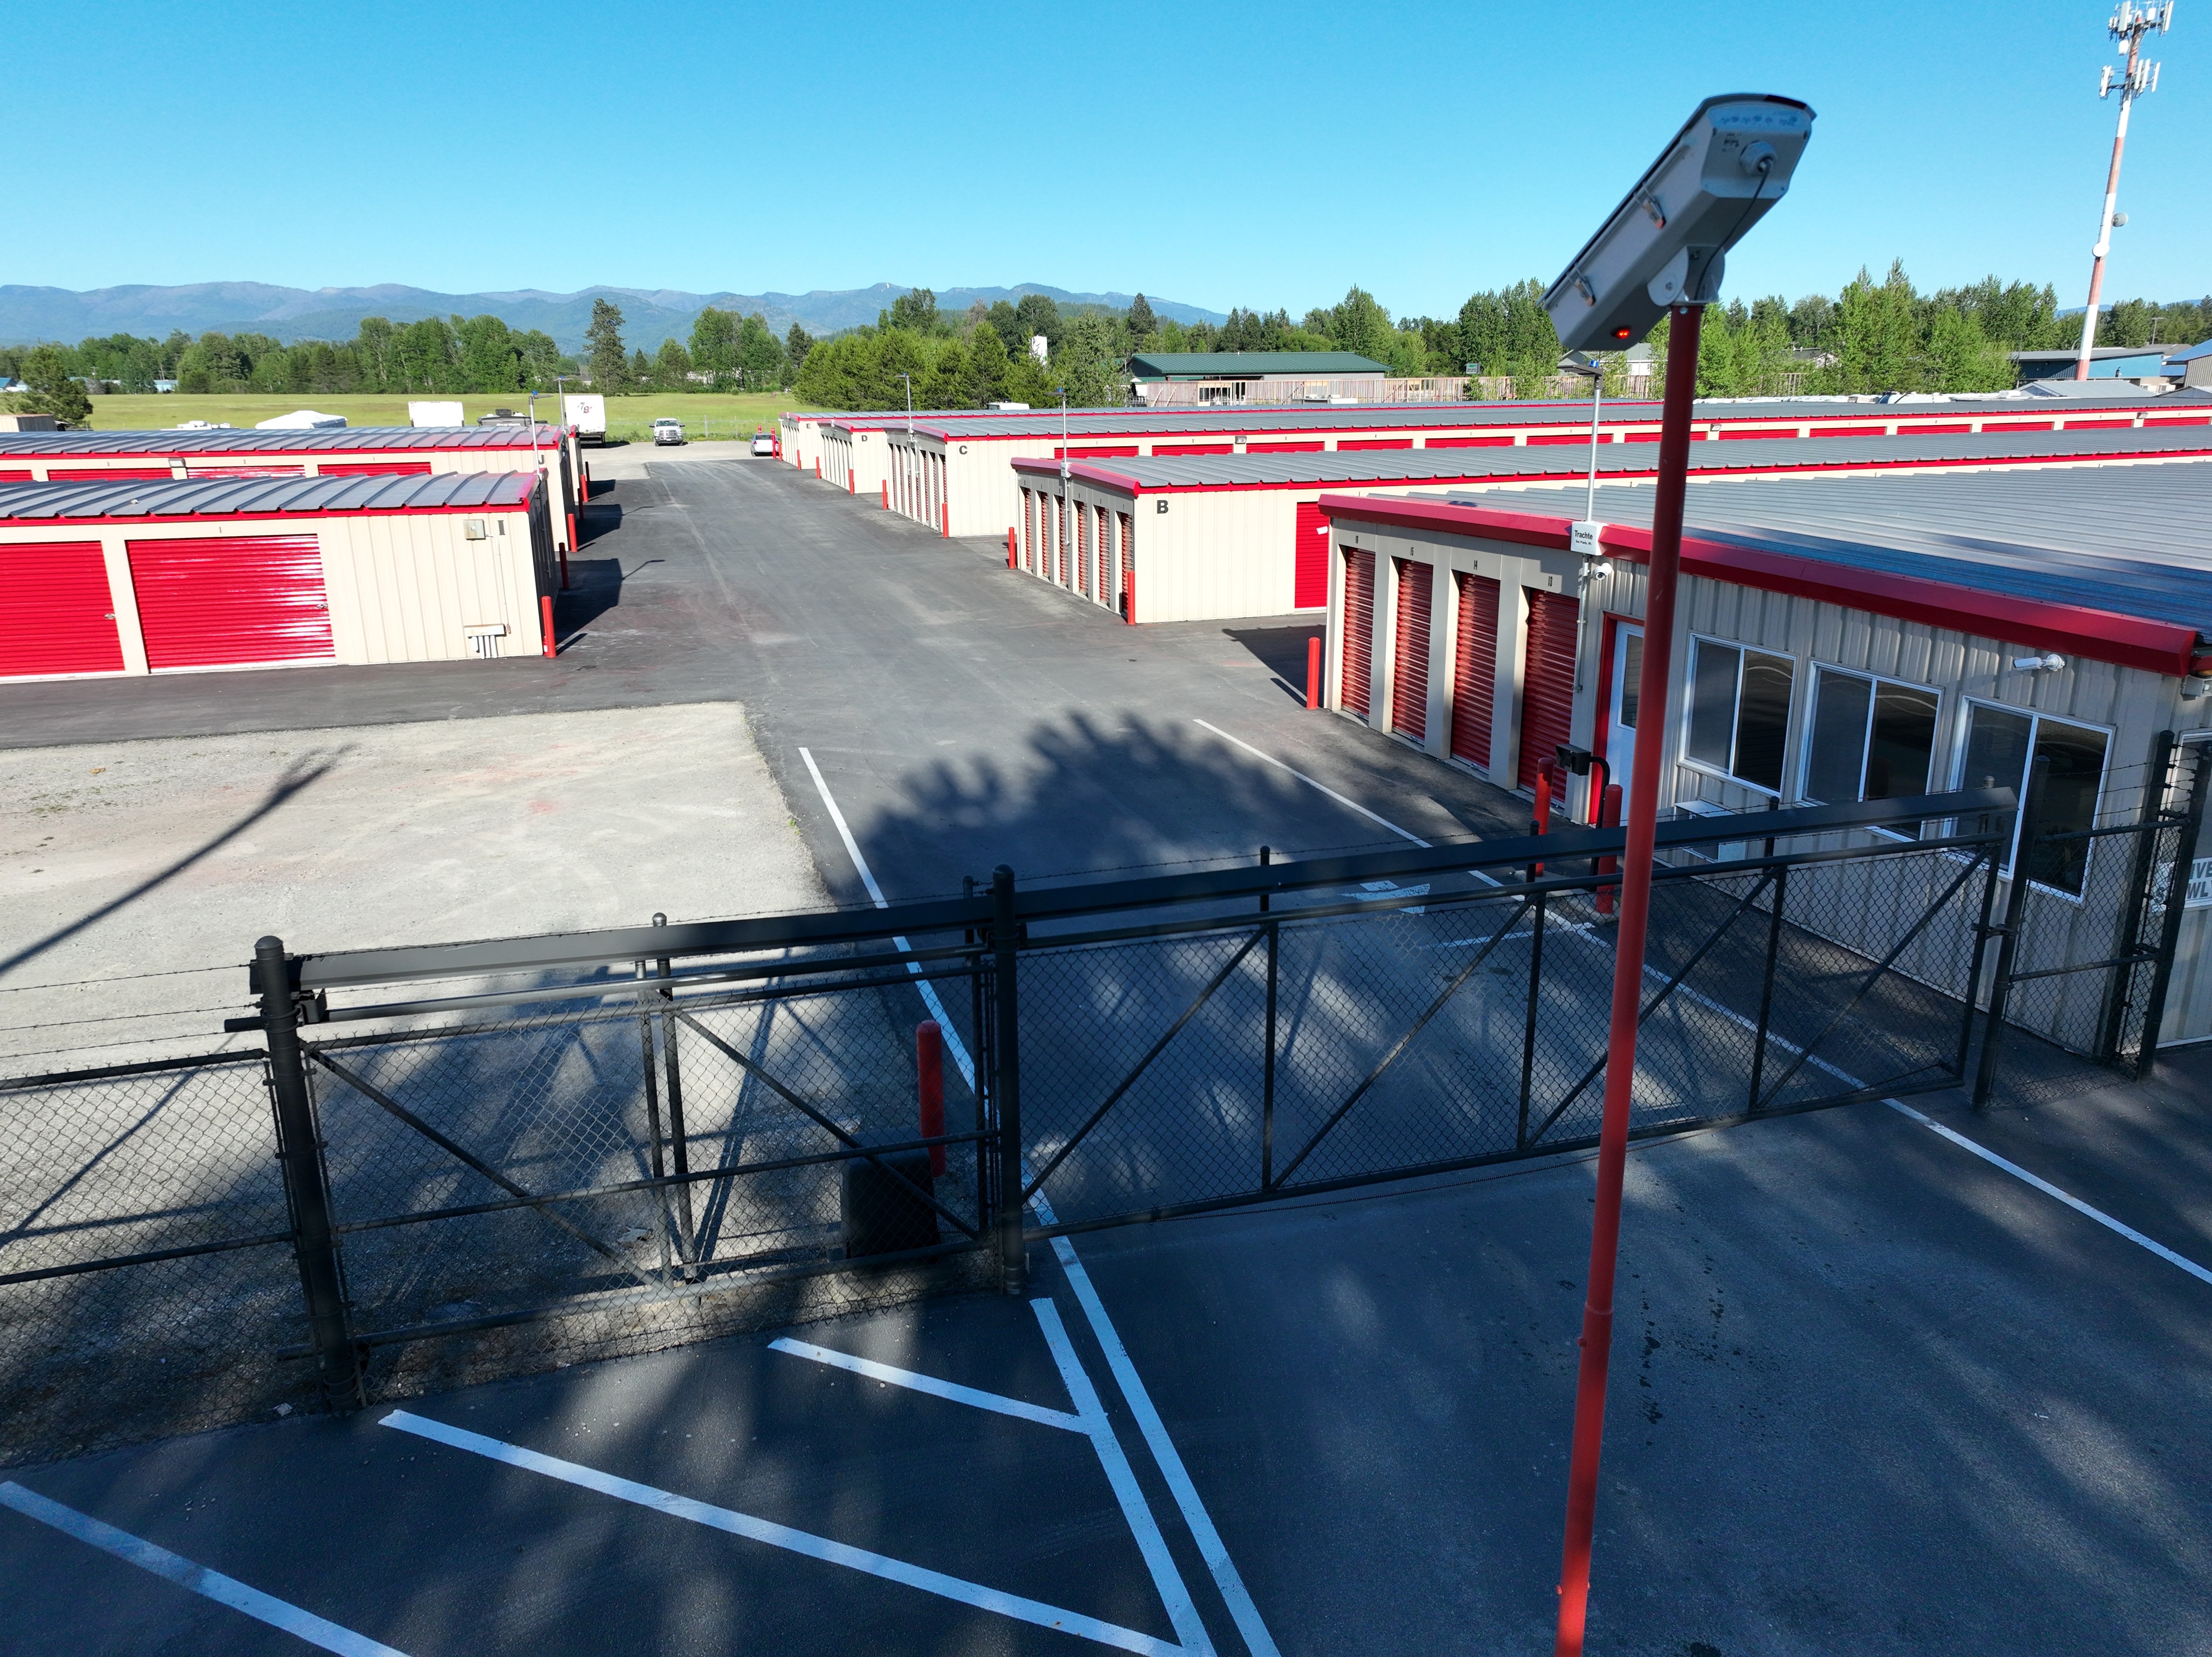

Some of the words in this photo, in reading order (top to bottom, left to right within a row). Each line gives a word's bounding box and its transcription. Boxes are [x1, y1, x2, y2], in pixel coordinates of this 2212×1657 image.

[959, 445, 968, 455] C
[538, 454, 544, 465] J
[1156, 500, 1169, 514] B
[498, 520, 506, 535] I
[1574, 530, 1593, 540] Trachte
[1410, 547, 1414, 556] 15
[1474, 560, 1478, 570] 14
[1548, 576, 1553, 587] 13
